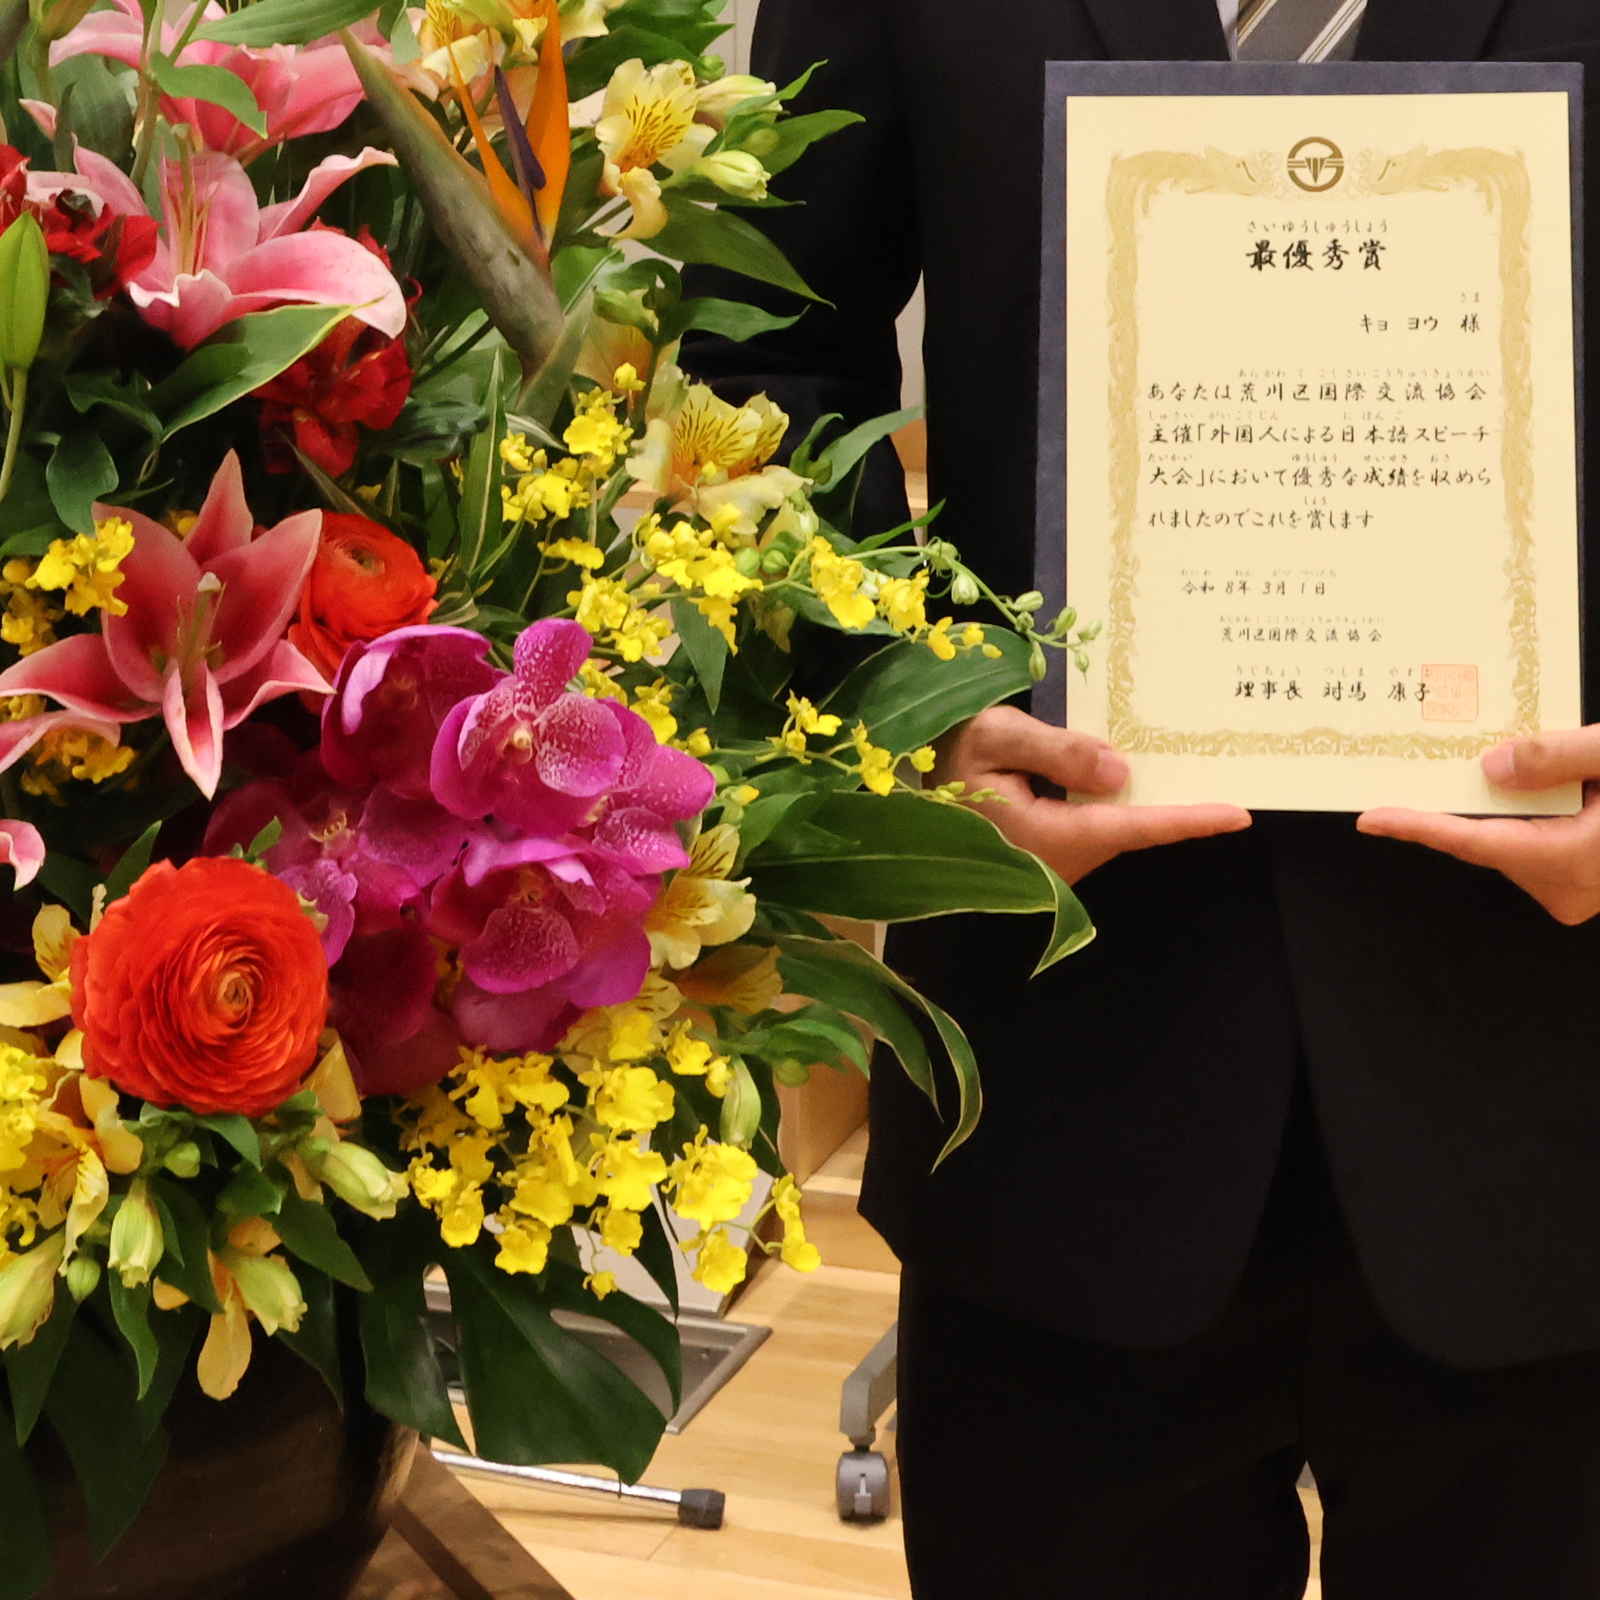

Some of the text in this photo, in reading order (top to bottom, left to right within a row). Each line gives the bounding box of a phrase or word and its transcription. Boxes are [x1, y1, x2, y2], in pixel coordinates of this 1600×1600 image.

[1246, 219, 1389, 234] さいゆうしゅうしょう
[1245, 238, 1387, 271] 最優秀賞
[1147, 381, 1488, 403] あなたは荒川区国際交流協会
[1148, 422, 1490, 445] 主催「外国人による日本語スピーチ
[1148, 465, 1492, 488] 大会」において優秀な成績を収めら
[1148, 508, 1374, 531] れましたのでこれを賞します
[1221, 626, 1383, 643] 荒川区国際交流協会
[1234, 679, 1303, 701] 理事長
